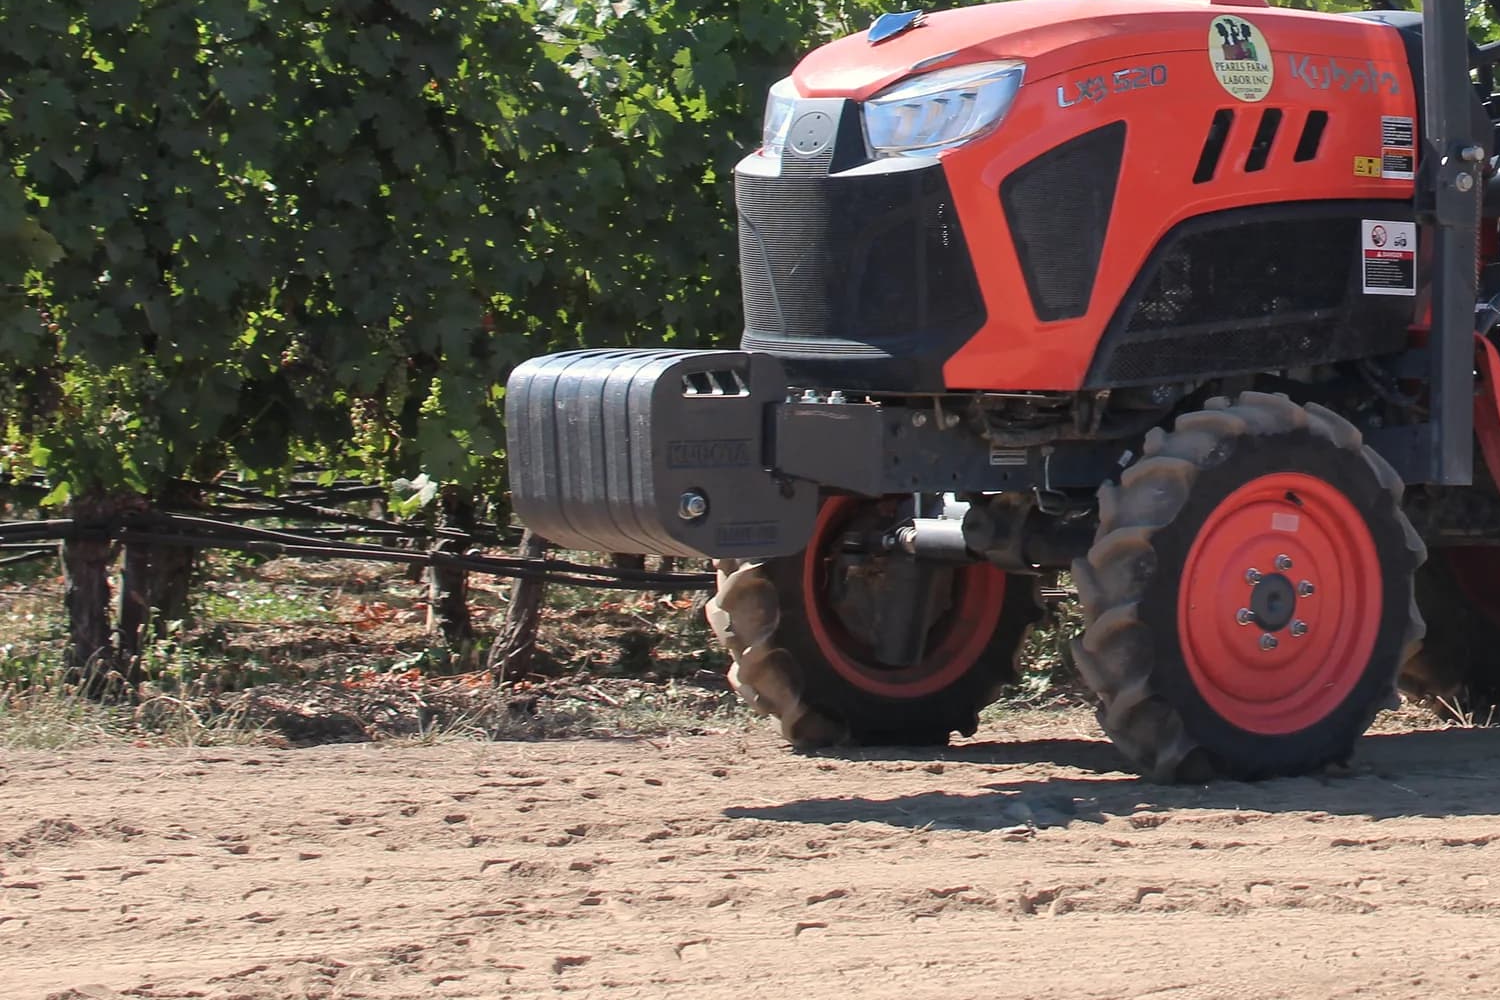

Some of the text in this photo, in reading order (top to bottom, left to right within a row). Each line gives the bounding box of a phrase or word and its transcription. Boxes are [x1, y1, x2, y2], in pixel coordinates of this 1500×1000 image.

[1215, 62, 1269, 72] PEARLS FARM
[1288, 55, 1400, 94] Kubota
[1223, 75, 1269, 85] LABOR INC
